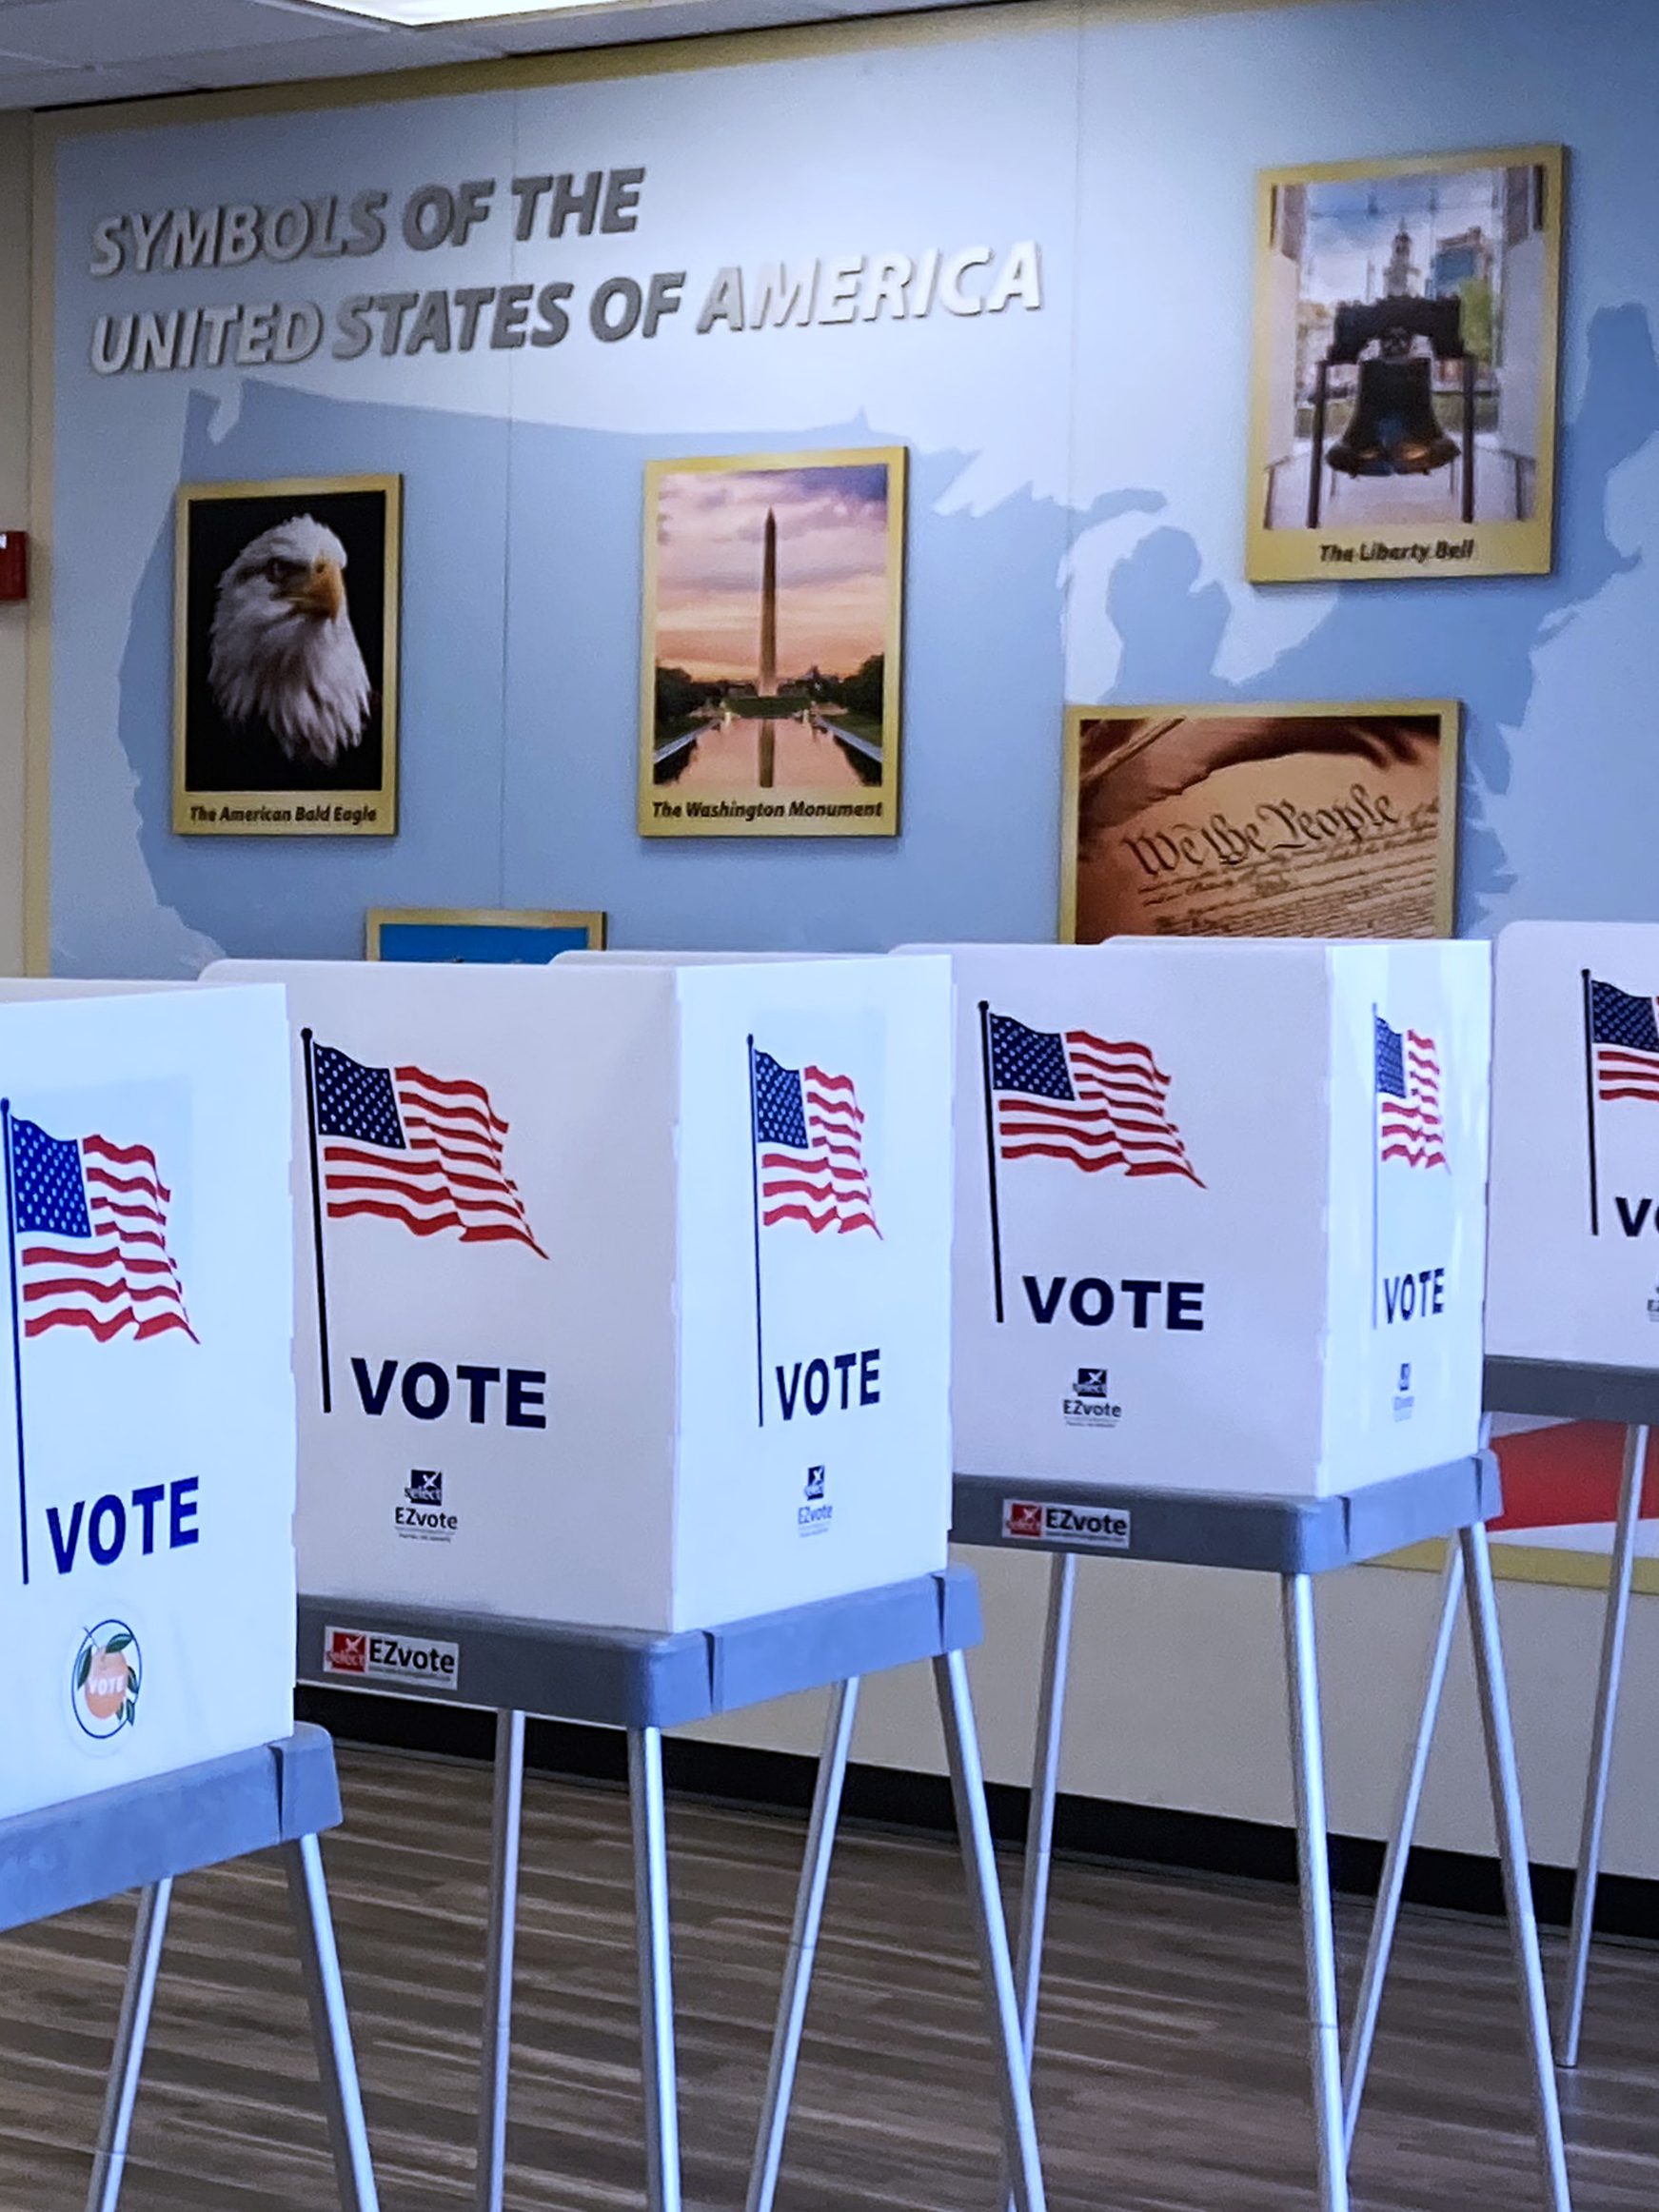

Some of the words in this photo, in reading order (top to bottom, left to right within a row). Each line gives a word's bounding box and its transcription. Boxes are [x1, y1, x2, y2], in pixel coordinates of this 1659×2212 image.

[90, 191, 387, 278] SYMBOLS
[403, 178, 494, 251] OF
[510, 167, 645, 242] THE
[93, 299, 323, 375] UNITED
[332, 282, 573, 360] STATES
[589, 270, 686, 344] OF
[696, 240, 1043, 335] AMERICA
[1319, 544, 1353, 563] The
[1359, 542, 1428, 563] Liberty
[1435, 539, 1474, 560] Bell
[190, 806, 216, 821] The
[219, 805, 292, 822] American
[295, 805, 330, 822] Bald
[333, 805, 378, 825] Eagle
[652, 801, 681, 819] The
[686, 800, 785, 821] Washington
[788, 801, 883, 818] Monument
[1121, 823, 1205, 875] We
[1256, 783, 1401, 849] People
[1021, 1275, 1205, 1331] VOTE
[1384, 1268, 1445, 1324] VOTE
[349, 1357, 547, 1429] VOTE
[776, 1349, 880, 1421] VOTE
[1063, 1399, 1122, 1418] EZvote
[46, 1475, 199, 1574] VOTE
[395, 1506, 458, 1530] EZvote
[1046, 1508, 1127, 1536] EZvote
[369, 1638, 455, 1673] EZvote
[88, 1674, 125, 1696] VOTE
